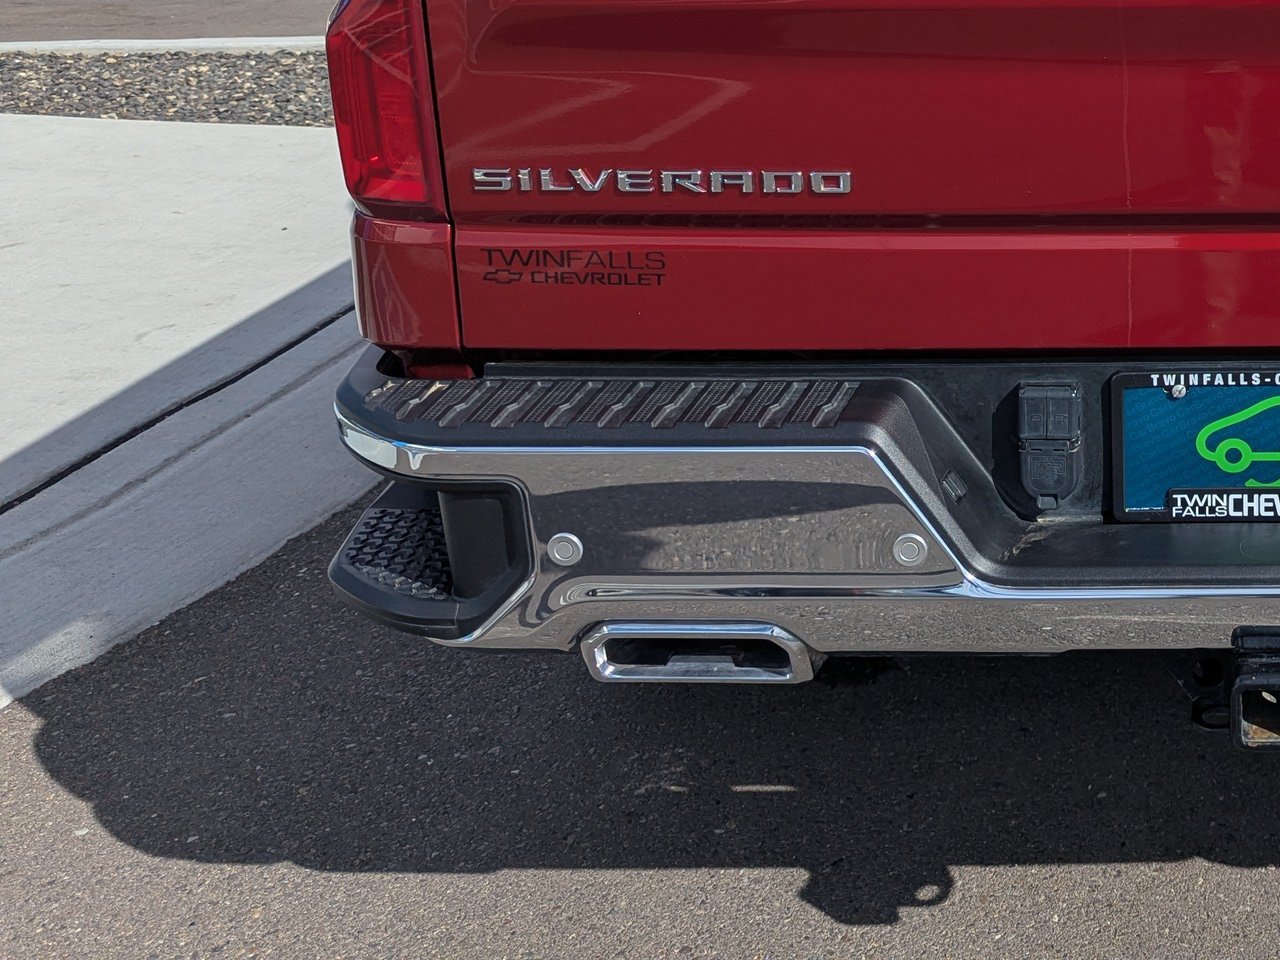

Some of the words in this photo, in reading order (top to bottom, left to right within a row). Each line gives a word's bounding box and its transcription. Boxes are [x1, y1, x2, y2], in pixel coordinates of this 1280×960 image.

[472, 167, 852, 194] SILVERADO
[481, 248, 666, 270] TWINFALLS
[530, 270, 666, 286] CHEVROLET
[1172, 494, 1227, 507] TWIN
[1172, 506, 1227, 517] FALLS
